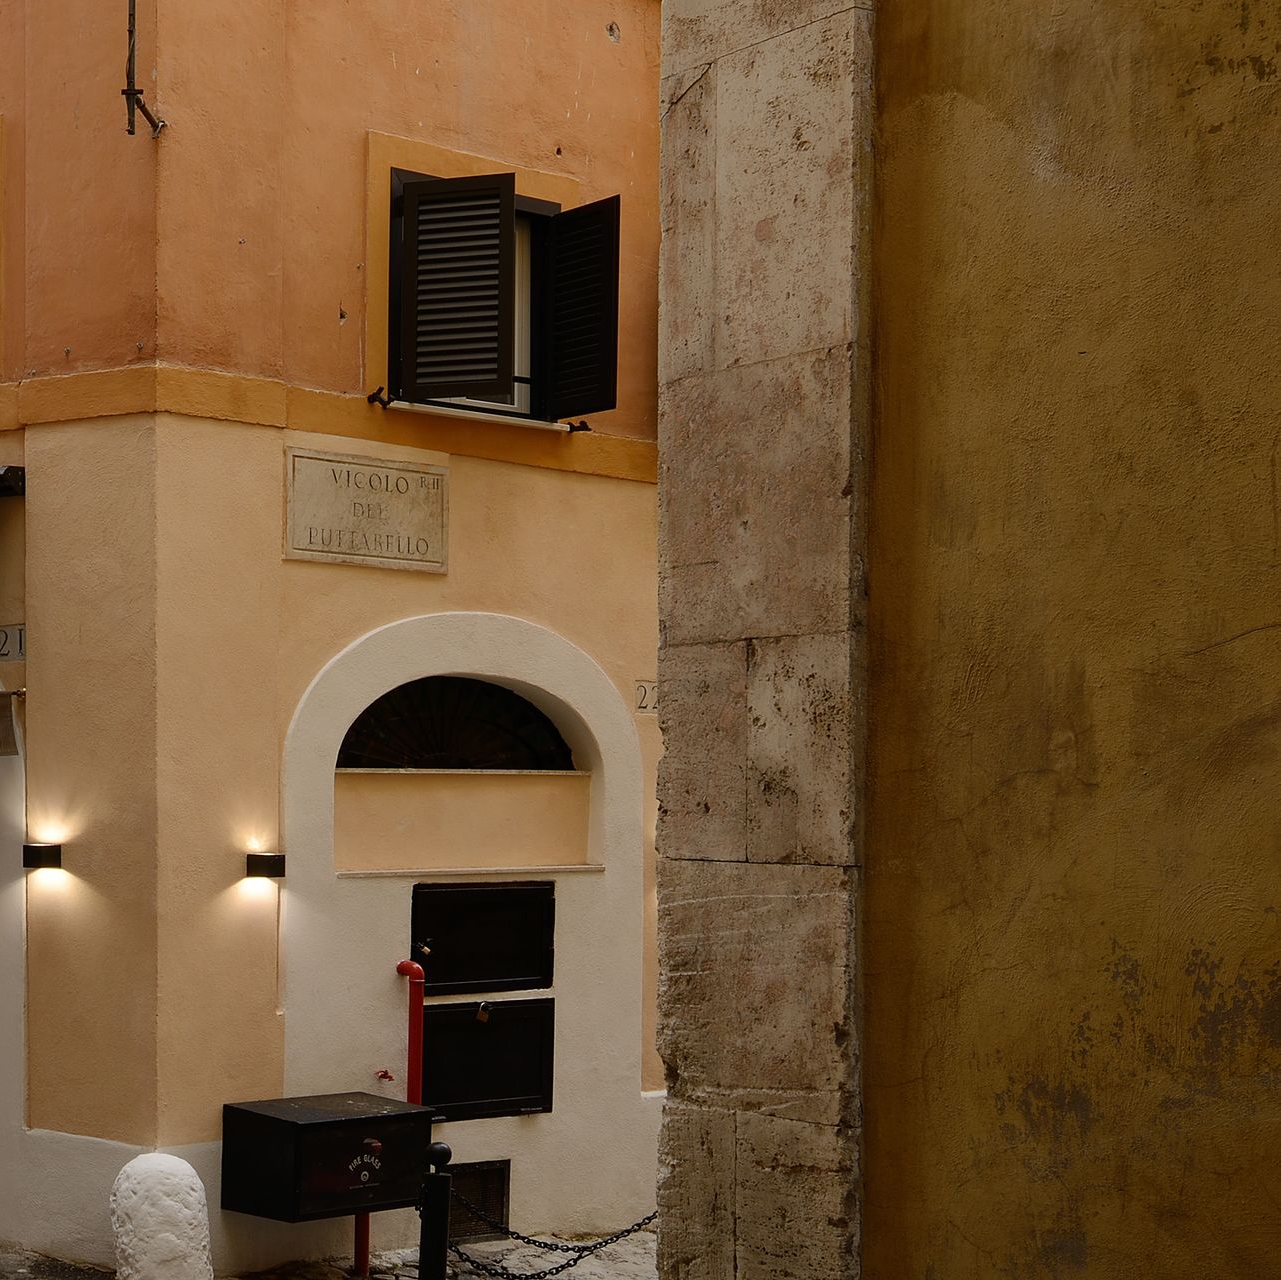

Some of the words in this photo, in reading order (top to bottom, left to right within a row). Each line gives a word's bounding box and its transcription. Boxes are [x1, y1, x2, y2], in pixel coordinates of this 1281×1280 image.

[331, 468, 410, 495] VICOLO
[352, 502, 389, 521] DEL
[307, 526, 430, 556] PUTTARELLO
[348, 1155, 362, 1171] FIRE
[363, 1153, 382, 1170] GLASS
